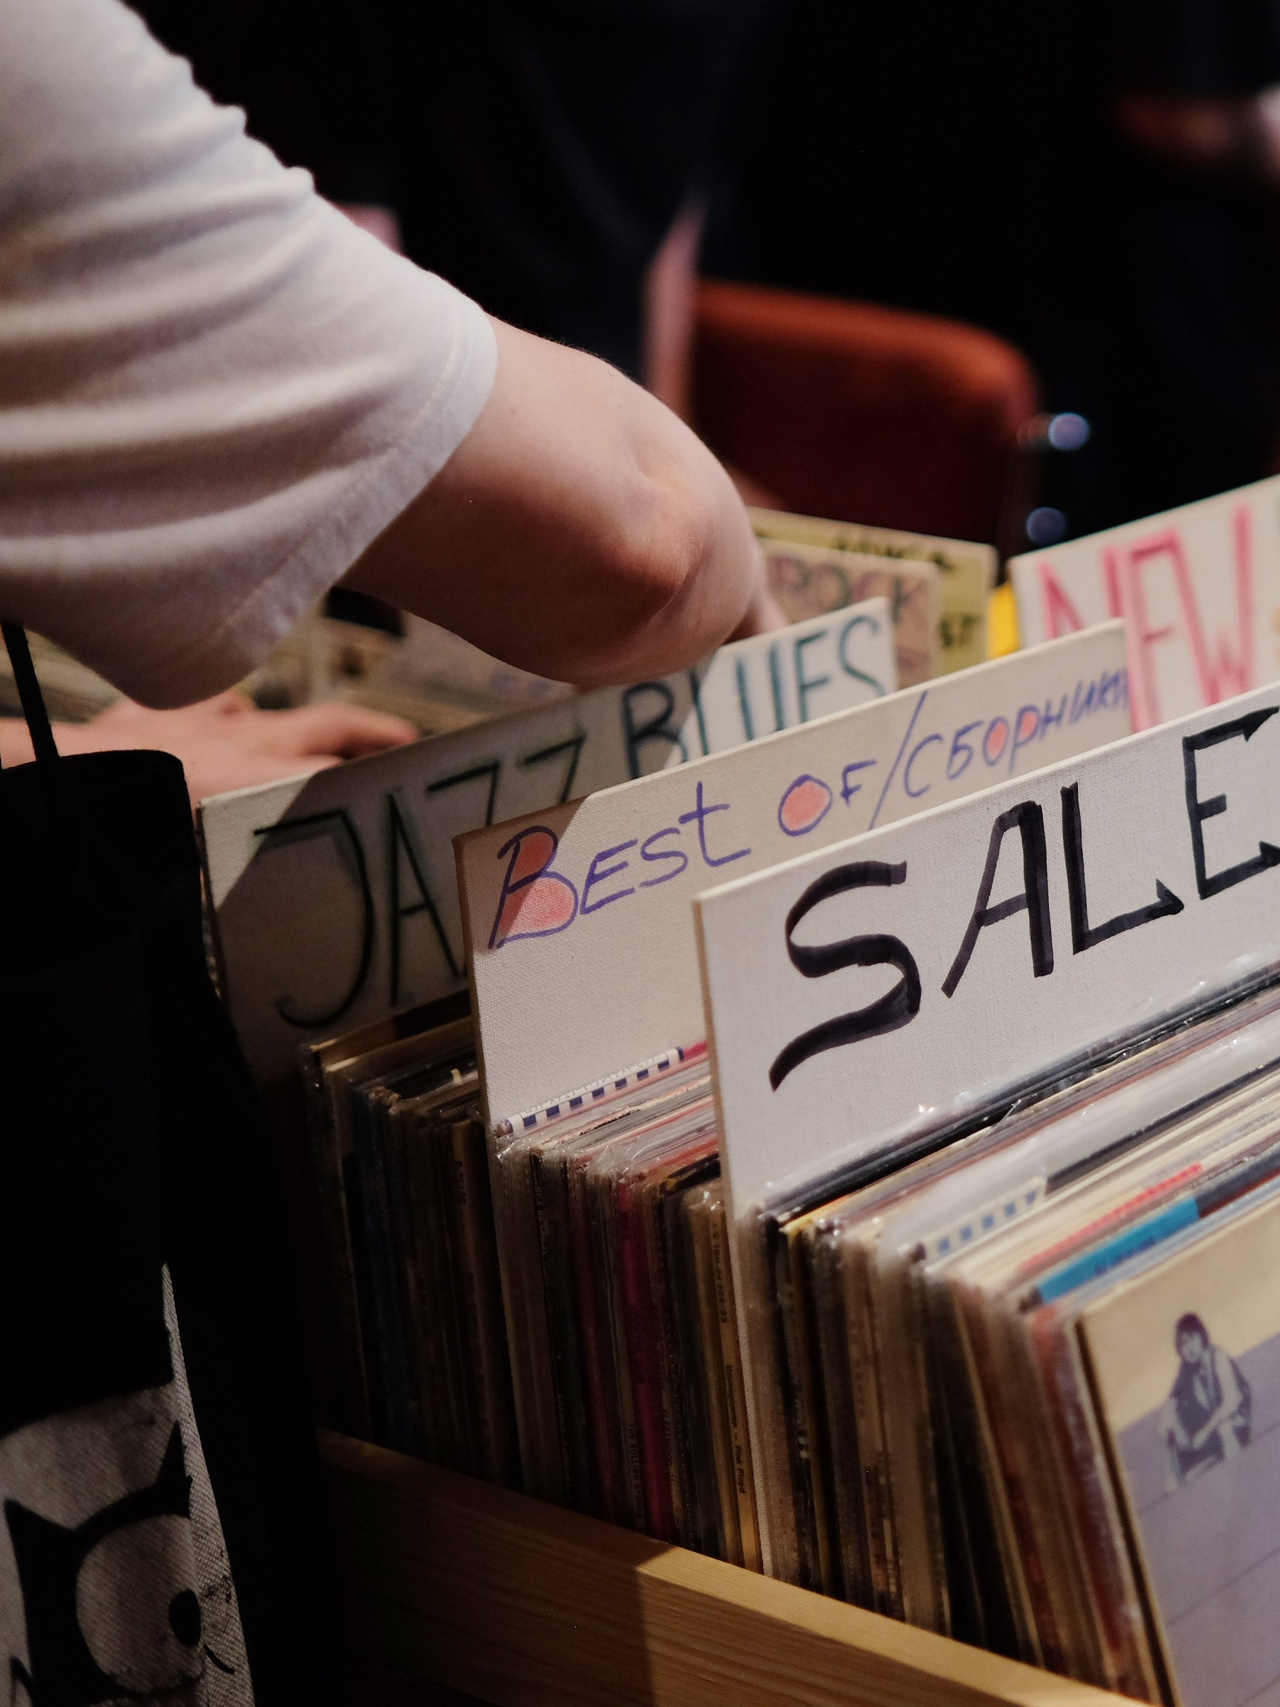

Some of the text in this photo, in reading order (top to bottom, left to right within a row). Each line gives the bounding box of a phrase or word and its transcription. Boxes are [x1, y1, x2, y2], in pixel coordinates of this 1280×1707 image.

[621, 614, 888, 781] BLUES
[1036, 502, 1256, 735] NEW
[252, 733, 587, 1030] JAZZ
[735, 1466, 747, 1495] Floyd
